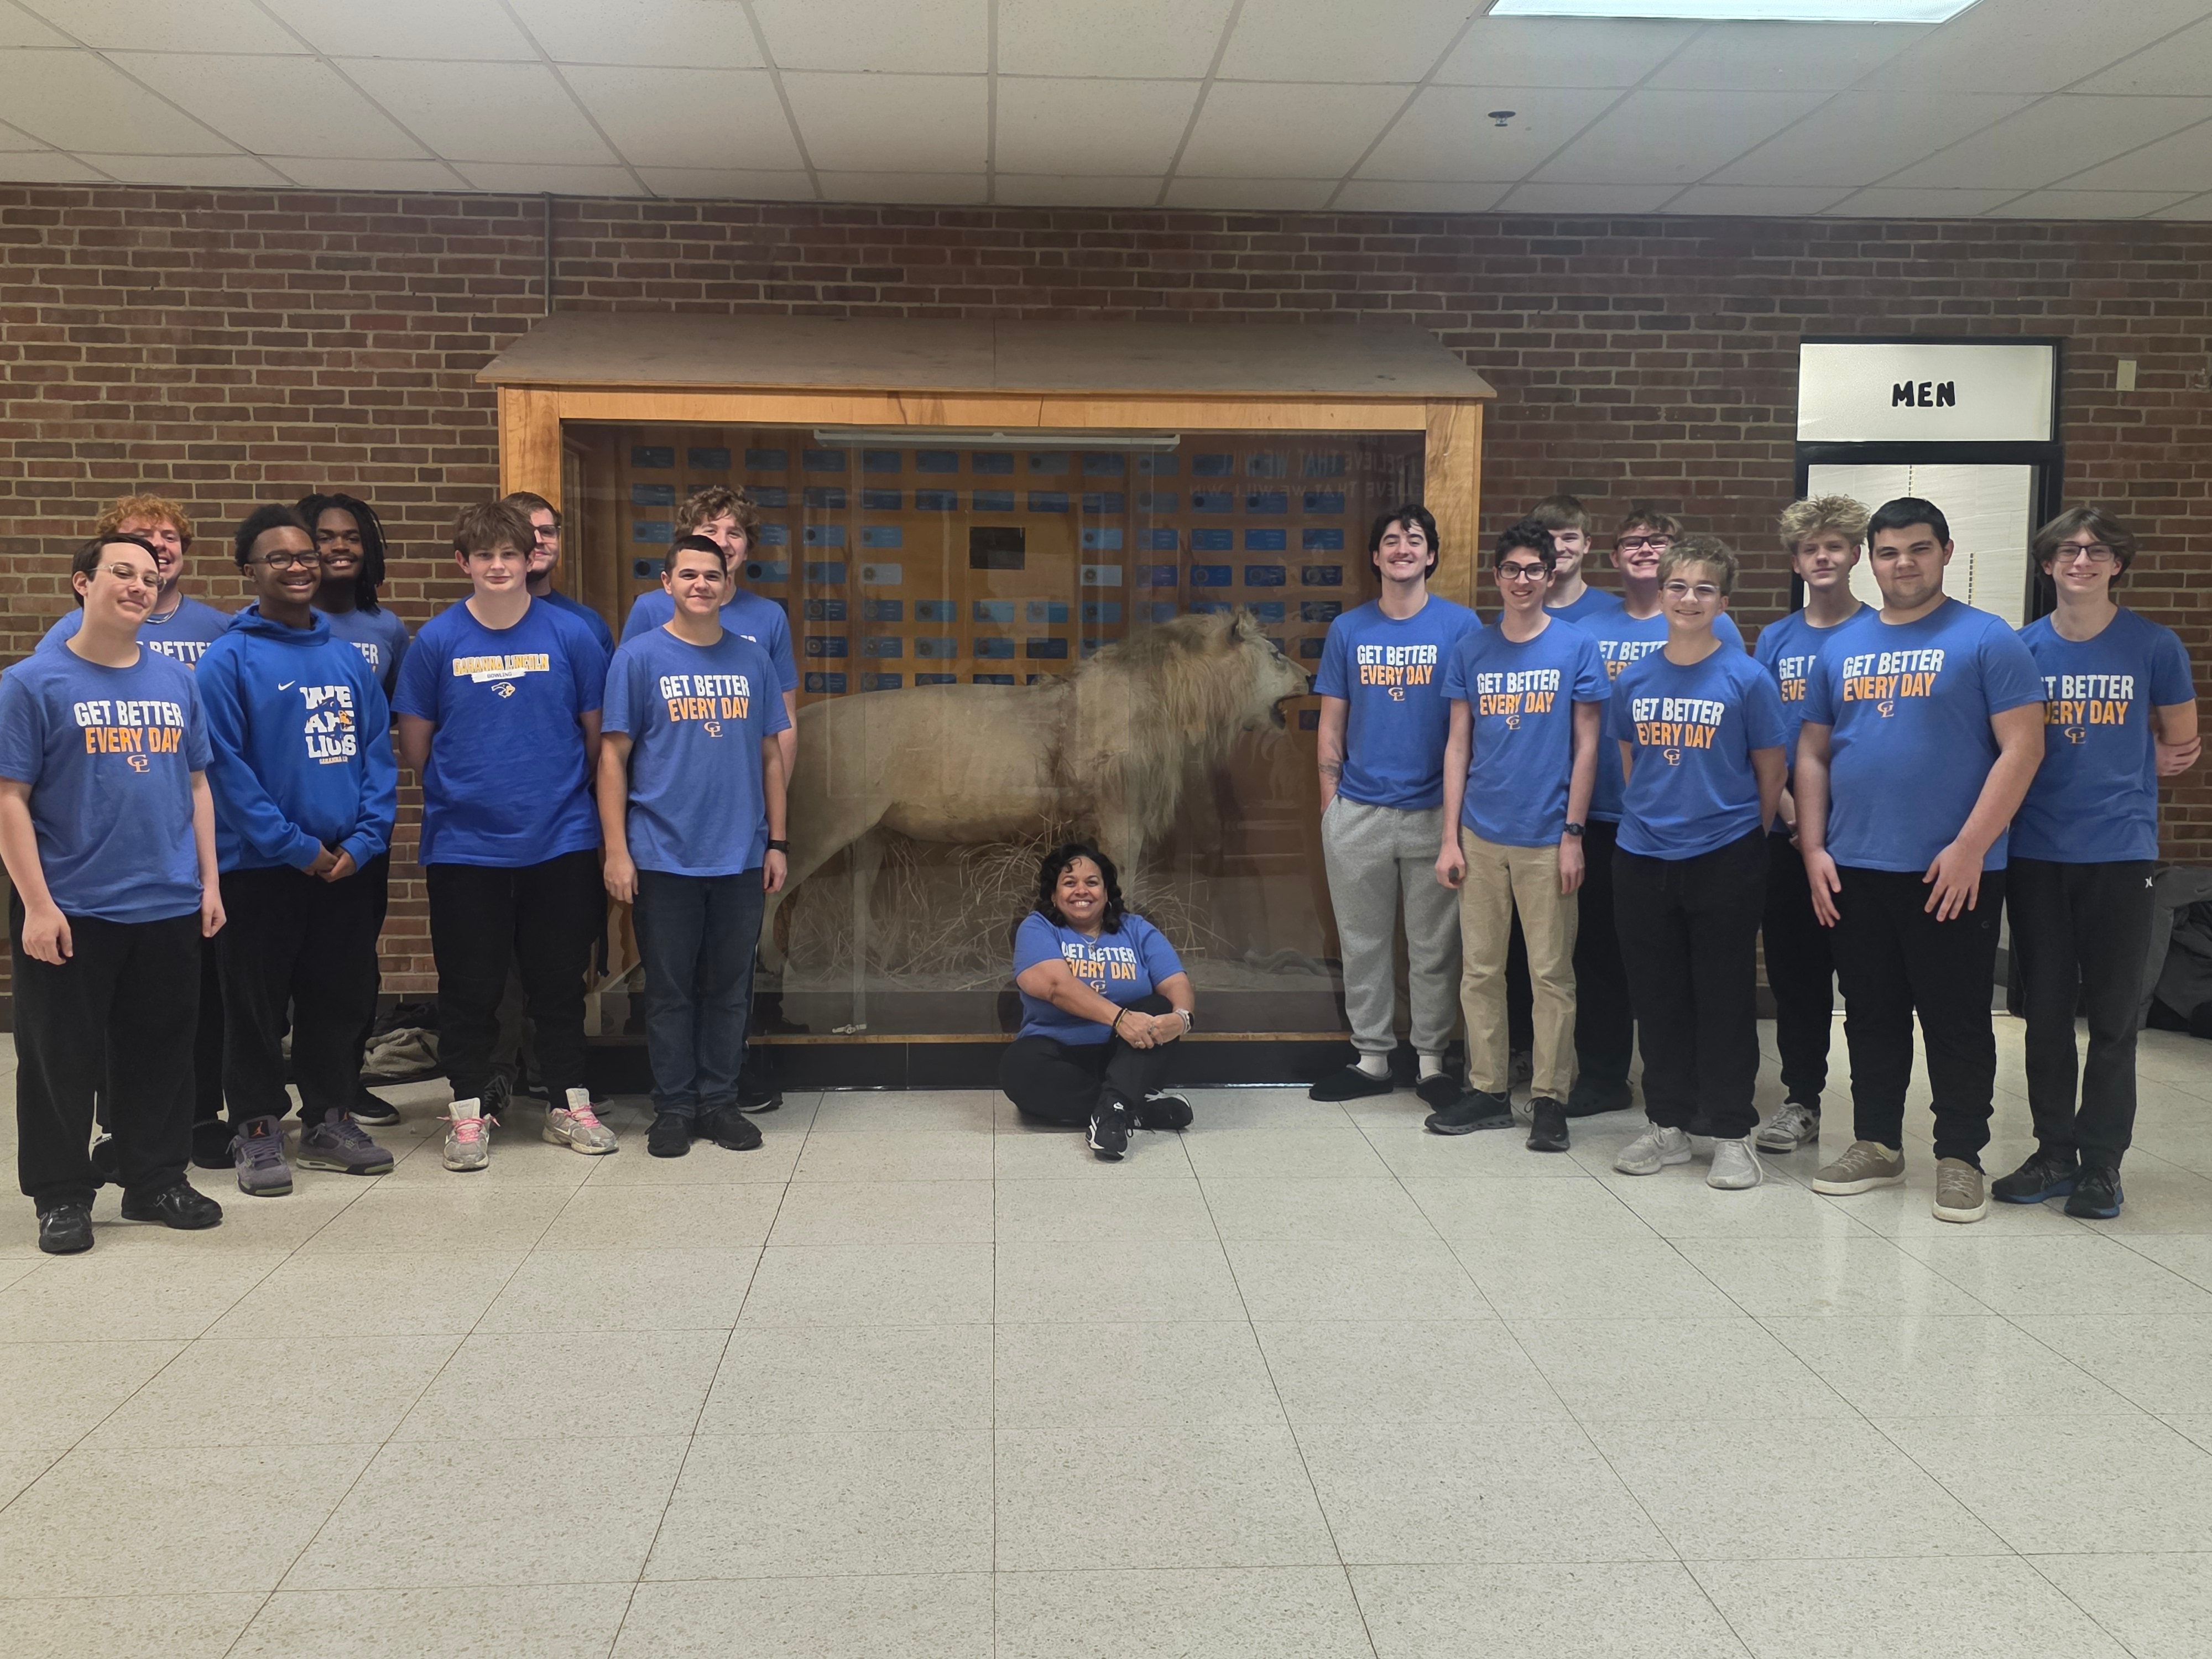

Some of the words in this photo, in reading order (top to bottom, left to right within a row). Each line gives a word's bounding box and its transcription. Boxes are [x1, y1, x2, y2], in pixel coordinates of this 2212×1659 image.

[1892, 380, 1955, 407] MEN
[149, 641, 212, 662] BETTE
[1357, 645, 1383, 664] GET
[1386, 645, 1437, 666] BETTER
[1599, 640, 1618, 660] ET
[1619, 640, 1669, 660] BETT
[452, 655, 504, 676] GAHANNA
[504, 654, 550, 671] LINCOLN
[1360, 665, 1404, 685] EVERY
[1406, 665, 1433, 685] DAY
[1779, 656, 1804, 680] GET
[1843, 654, 1875, 679] GET
[1877, 649, 1944, 675] BETTER
[660, 675, 690, 700] GET
[693, 675, 750, 697] BETTER
[1477, 673, 1503, 694] GET
[1507, 669, 1560, 693] BETTER
[1781, 679, 1806, 702] EVE
[1844, 675, 1898, 701] EVERY
[1901, 672, 1936, 697] DAY
[2062, 675, 2134, 700] BETTER
[299, 686, 353, 709] WE
[667, 697, 716, 722] EVERY
[721, 697, 749, 719] DAY
[1480, 693, 1522, 715] EVERY
[1524, 691, 1554, 713] DAY
[74, 701, 111, 727] GET
[116, 701, 184, 727] BETTER
[1632, 698, 1659, 722] GET
[1662, 697, 1725, 726] BETTER
[2089, 700, 2128, 724] DAY
[85, 727, 143, 754] EVERY
[148, 727, 181, 753] DAY
[305, 734, 356, 758] LIOS
[1636, 722, 1682, 746] EVERY
[1684, 723, 1716, 749] DAY
[1110, 961, 1136, 980] DAY
